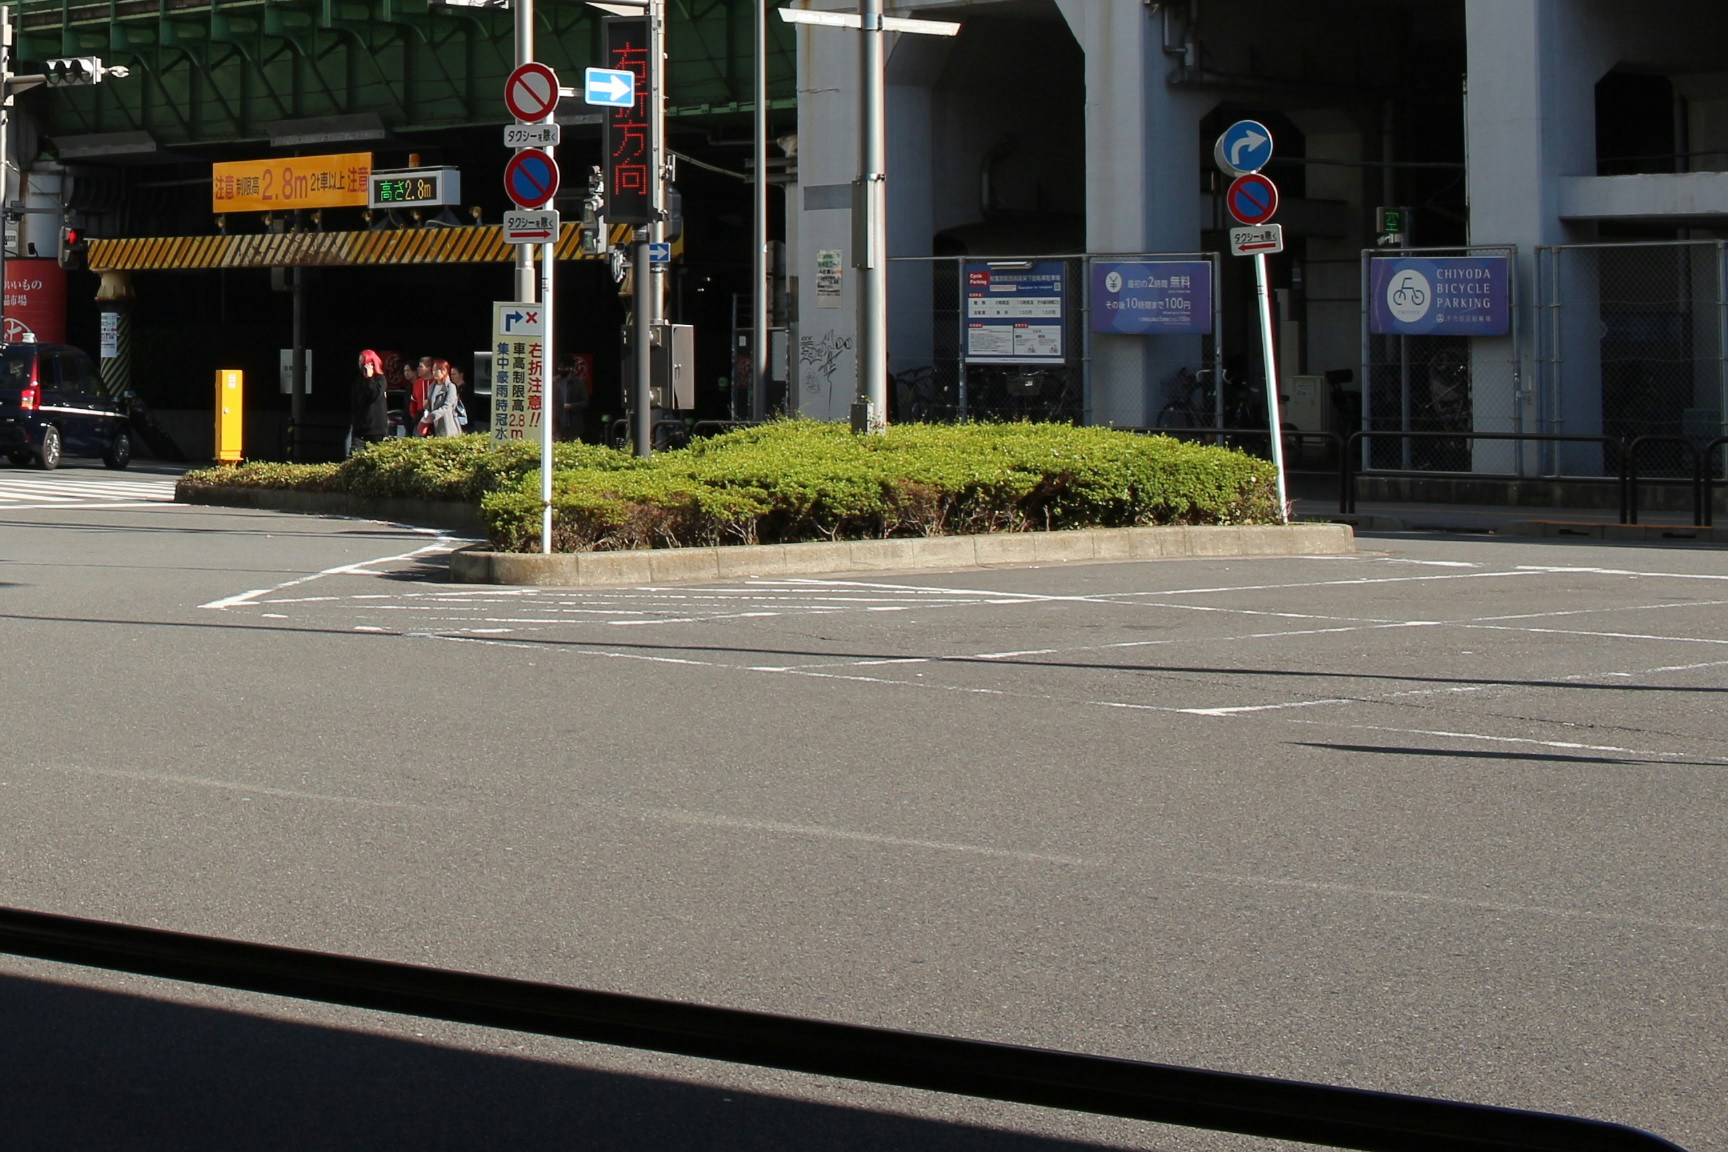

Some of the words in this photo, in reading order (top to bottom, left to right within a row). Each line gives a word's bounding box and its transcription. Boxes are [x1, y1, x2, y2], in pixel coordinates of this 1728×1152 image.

[507, 129, 556, 142] タクシーを除く
[215, 175, 234, 201] 注意
[235, 176, 260, 197] 制限高
[261, 167, 308, 201] 2.8m
[310, 172, 346, 193] 2t車以上
[347, 166, 369, 193] 注意
[380, 179, 432, 201] 高さ2.8m
[507, 216, 554, 228] タクシーを除く
[1234, 230, 1277, 243] タクシーを除く
[1436, 268, 1491, 280] CHIYODA
[1169, 275, 1190, 288] 無料
[1436, 283, 1491, 294] BICYCLE
[1436, 297, 1491, 308] PARKING
[495, 342, 510, 441] 集中豪雨時冠水
